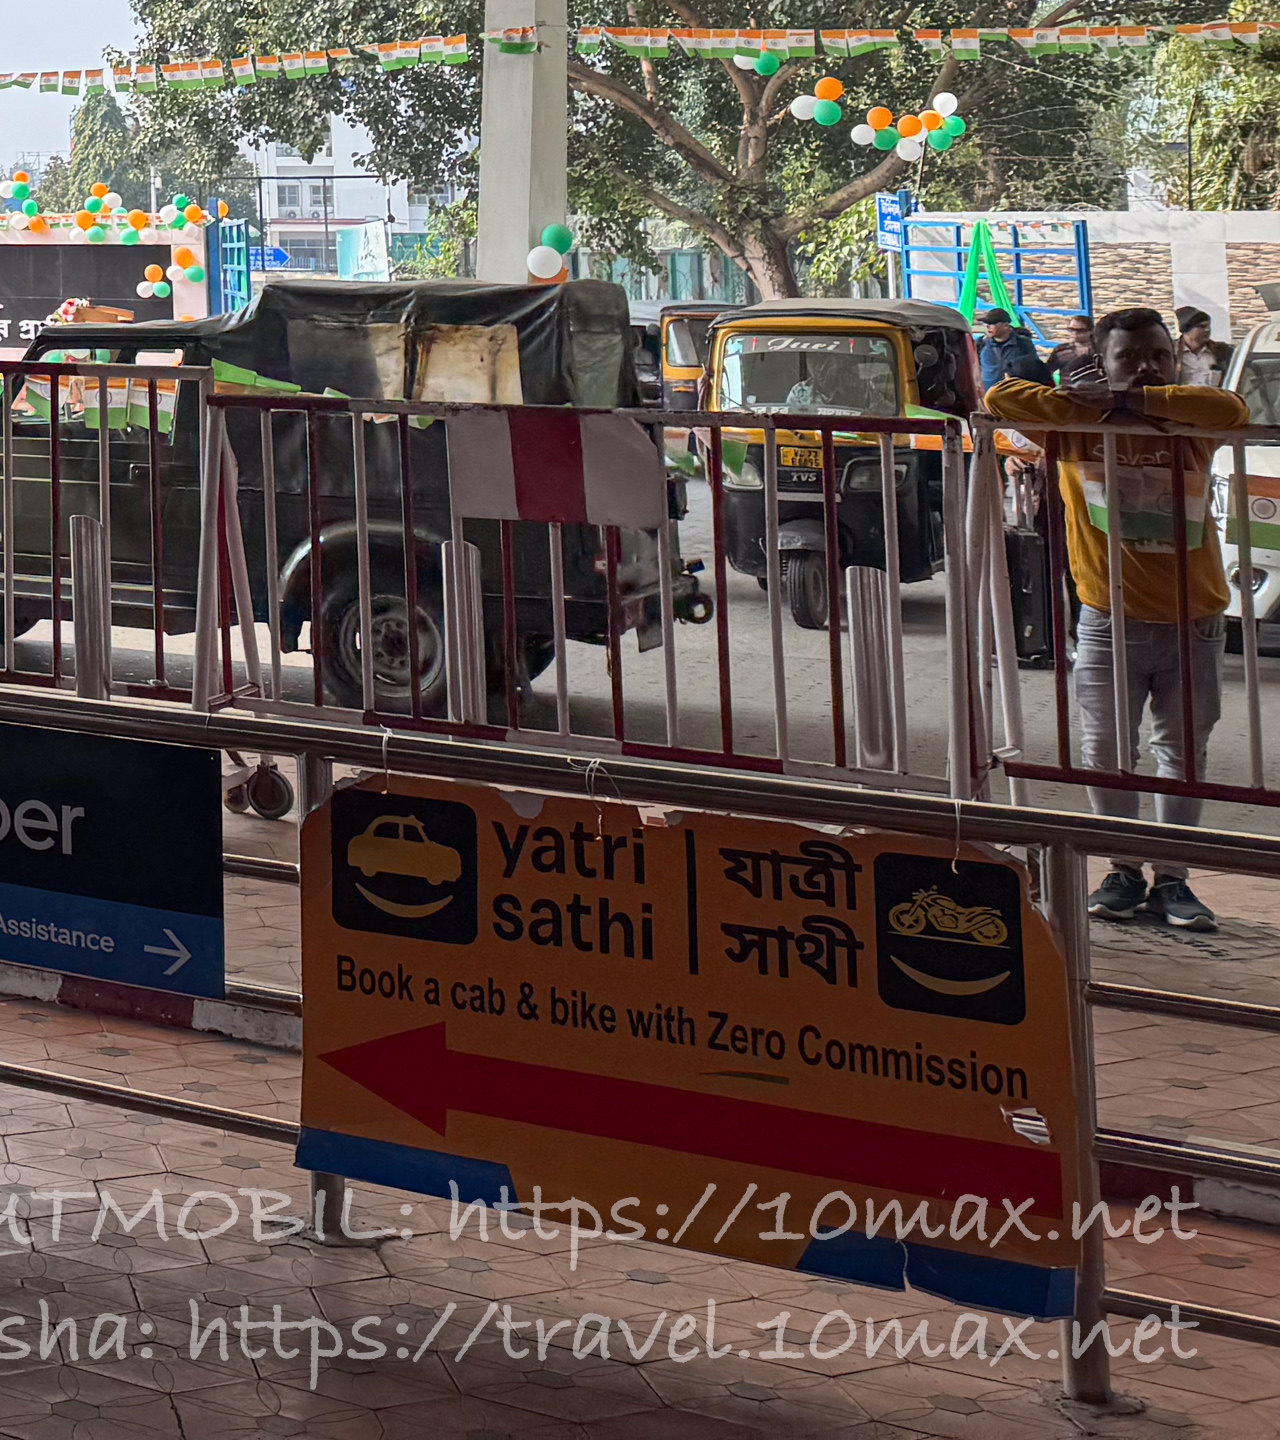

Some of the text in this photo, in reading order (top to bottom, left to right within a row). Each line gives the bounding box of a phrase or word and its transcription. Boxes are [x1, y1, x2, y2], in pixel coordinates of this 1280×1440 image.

[791, 471, 818, 482] TVS
[491, 820, 646, 885] yatri
[718, 839, 863, 911] যাত্রী
[491, 893, 654, 961] sathi
[720, 914, 865, 989] সাথী
[336, 955, 1030, 1102] Book a cab & bike with Zero Commission
